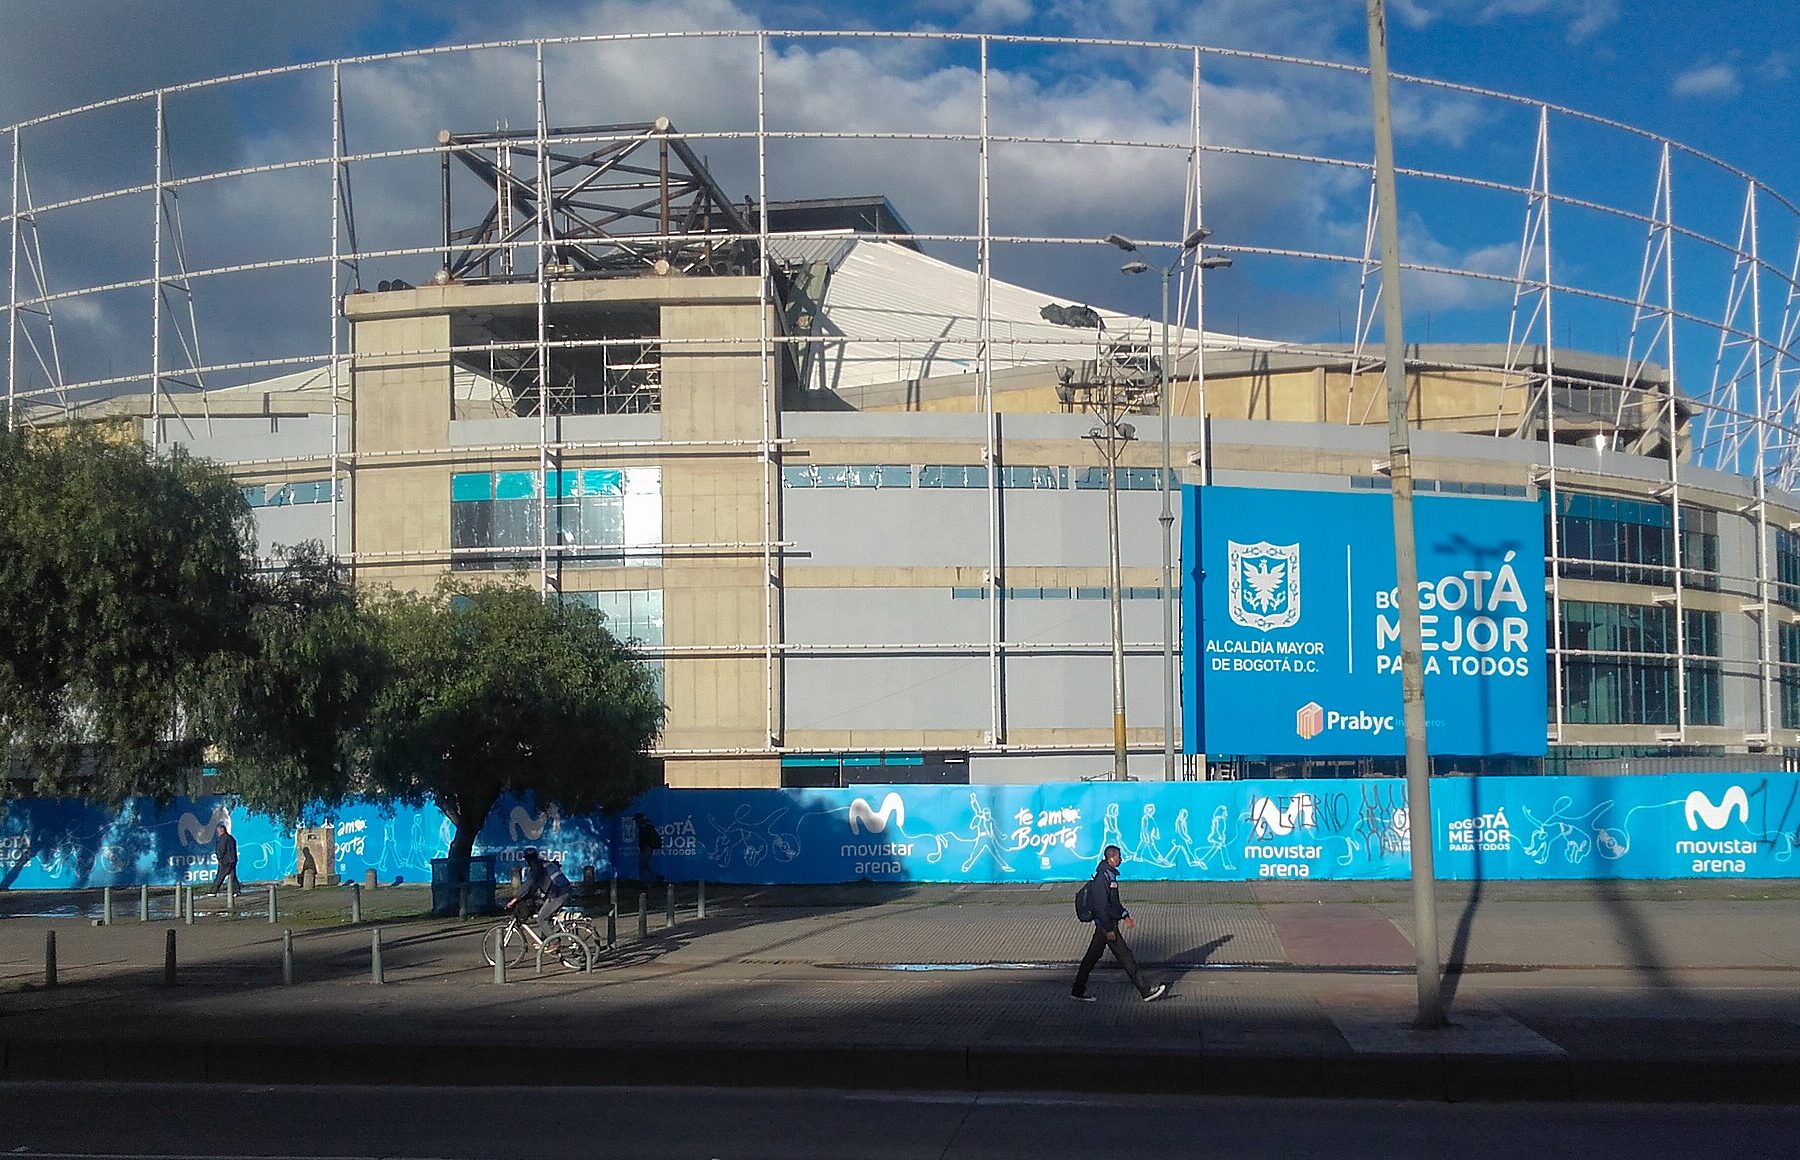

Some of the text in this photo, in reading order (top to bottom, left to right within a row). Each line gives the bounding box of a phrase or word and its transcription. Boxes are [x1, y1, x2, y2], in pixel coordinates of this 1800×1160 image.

[1376, 614, 1529, 653] MEJOR
[1206, 638, 1325, 655] ALCALDÍA MAYOR
[1211, 656, 1319, 673] DE BOGOTÁ D.C.
[1376, 655, 1529, 677] PAA TODOS
[1327, 710, 1394, 736] Prabyc
[1395, 716, 1447, 728] ineros
[1014, 807, 1033, 826] te
[1448, 806, 1510, 830] BOGOTÁ
[655, 815, 697, 835] GOTÁ
[661, 836, 697, 849] JOR
[1009, 825, 1082, 856] Bogotá
[1448, 829, 1510, 844] MEJOR
[335, 834, 368, 862] ogotá
[668, 848, 697, 856] TODOS
[841, 842, 915, 857] movistar
[1244, 843, 1323, 859] movistar
[1449, 842, 1511, 851] PARA TODOS
[1675, 839, 1758, 854] movistar
[168, 852, 241, 867] movis
[500, 848, 569, 863] mostar
[855, 861, 902, 874] arena
[1259, 863, 1310, 877] arena
[1692, 859, 1746, 873] arena
[184, 869, 228, 882] aren
